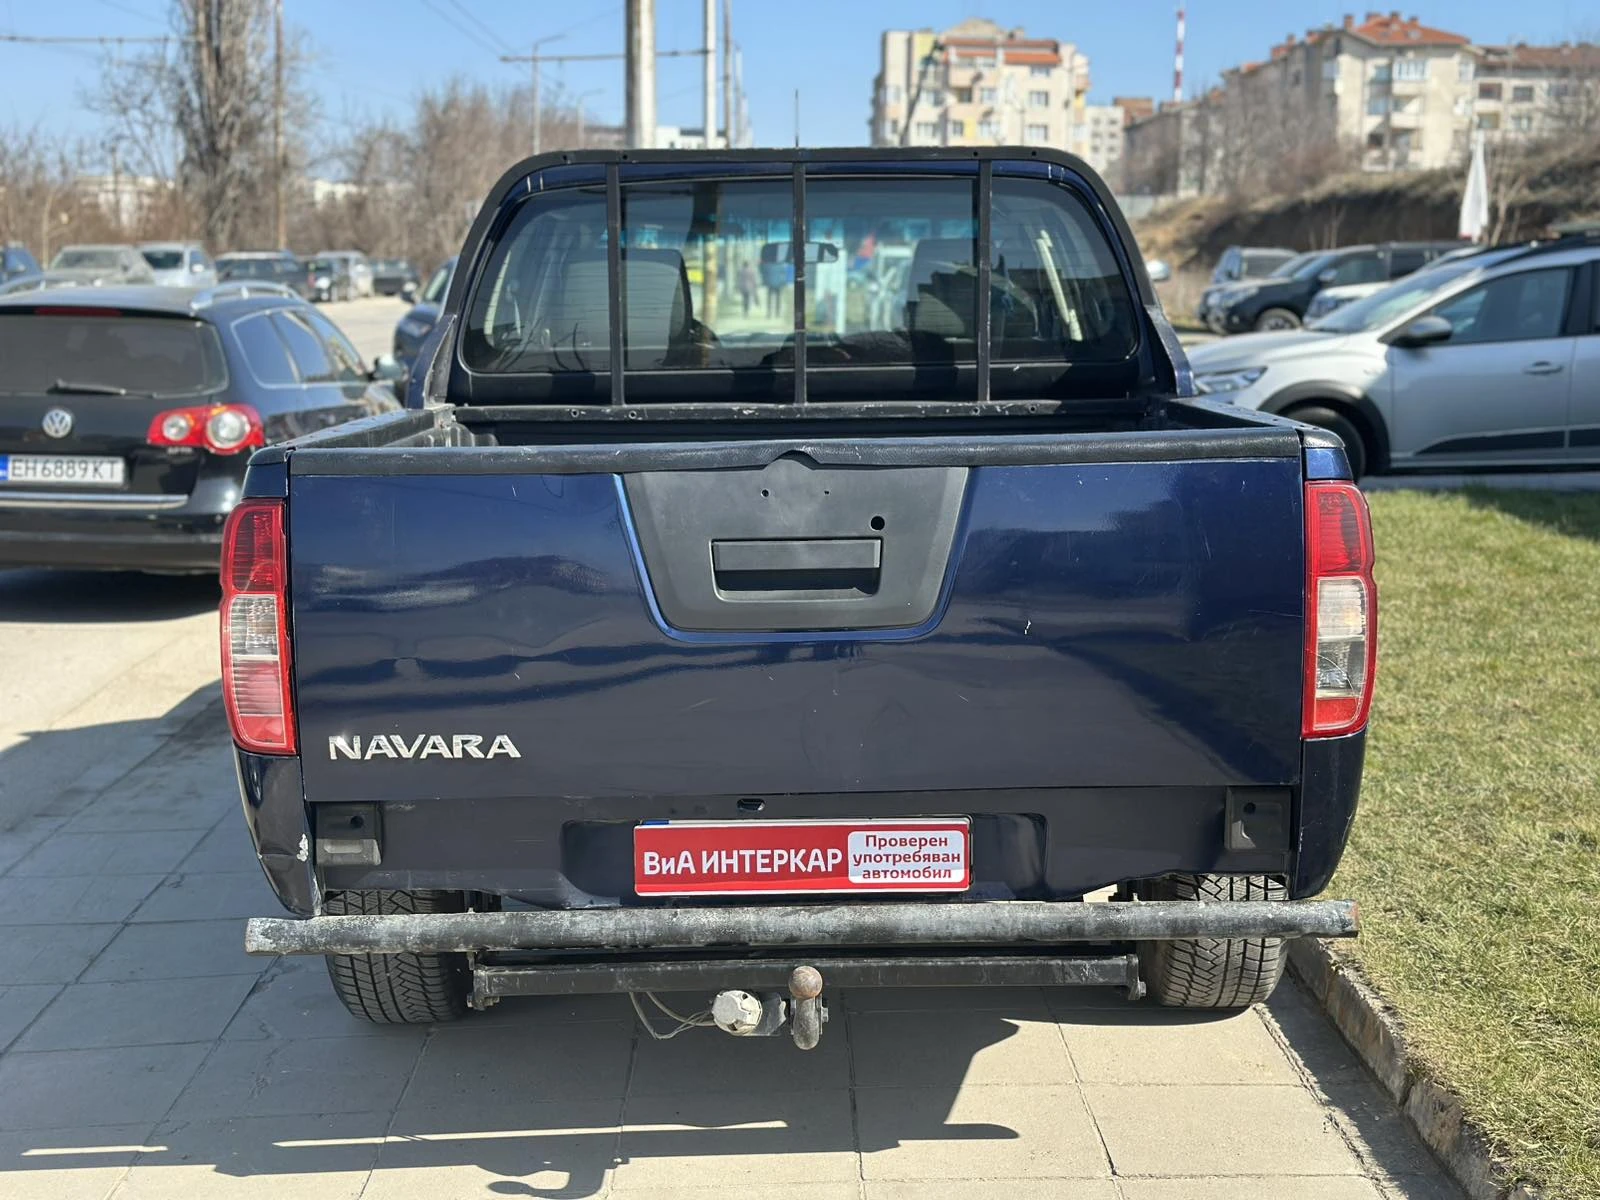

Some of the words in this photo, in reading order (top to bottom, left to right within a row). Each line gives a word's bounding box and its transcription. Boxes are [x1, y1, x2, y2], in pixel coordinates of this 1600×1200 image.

[328, 733, 521, 760] NAVARA
[865, 834, 949, 852] Проверен
[643, 850, 696, 875] ВиА
[702, 848, 843, 874] ИНТЕРКАР
[852, 849, 961, 867] употребяван
[861, 865, 952, 880] автомобил
